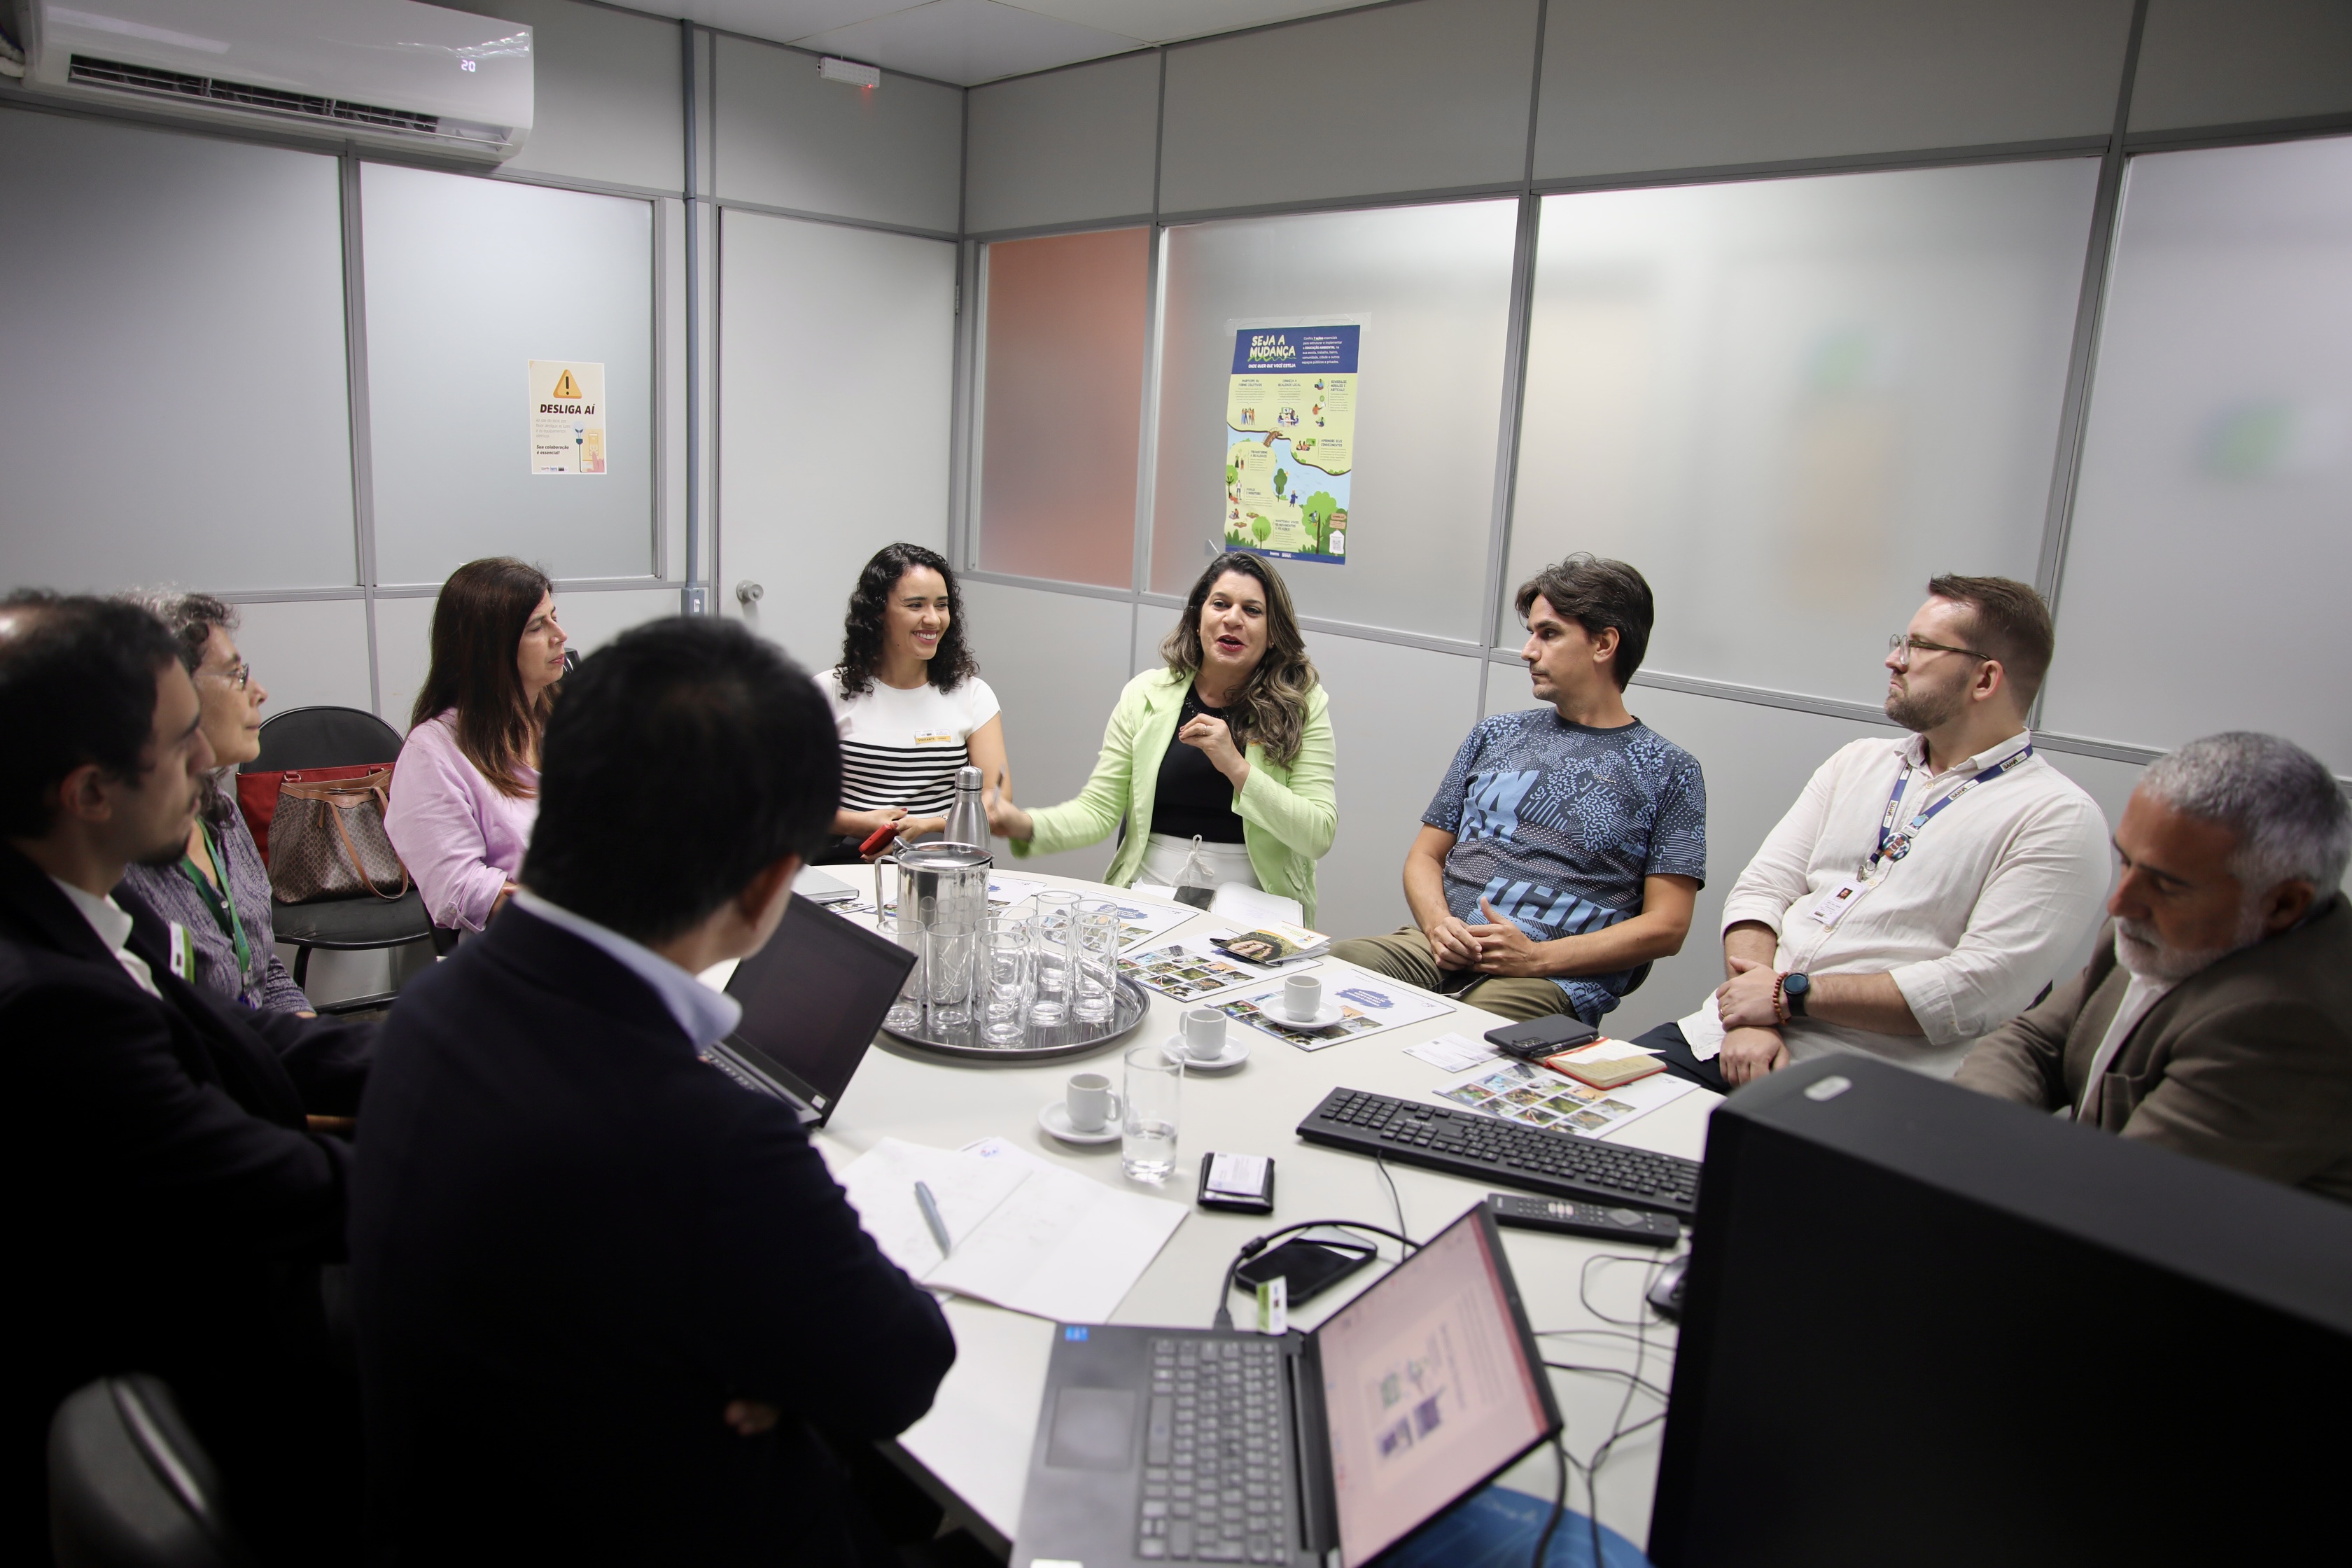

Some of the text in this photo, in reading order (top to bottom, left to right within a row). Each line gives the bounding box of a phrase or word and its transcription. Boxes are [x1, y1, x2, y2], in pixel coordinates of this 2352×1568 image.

[461, 59, 476, 72] 20
[1252, 335, 1285, 346] SEJA A
[1250, 346, 1296, 358] MUDANÇA
[540, 404, 596, 414] DESLIGA AÍ
